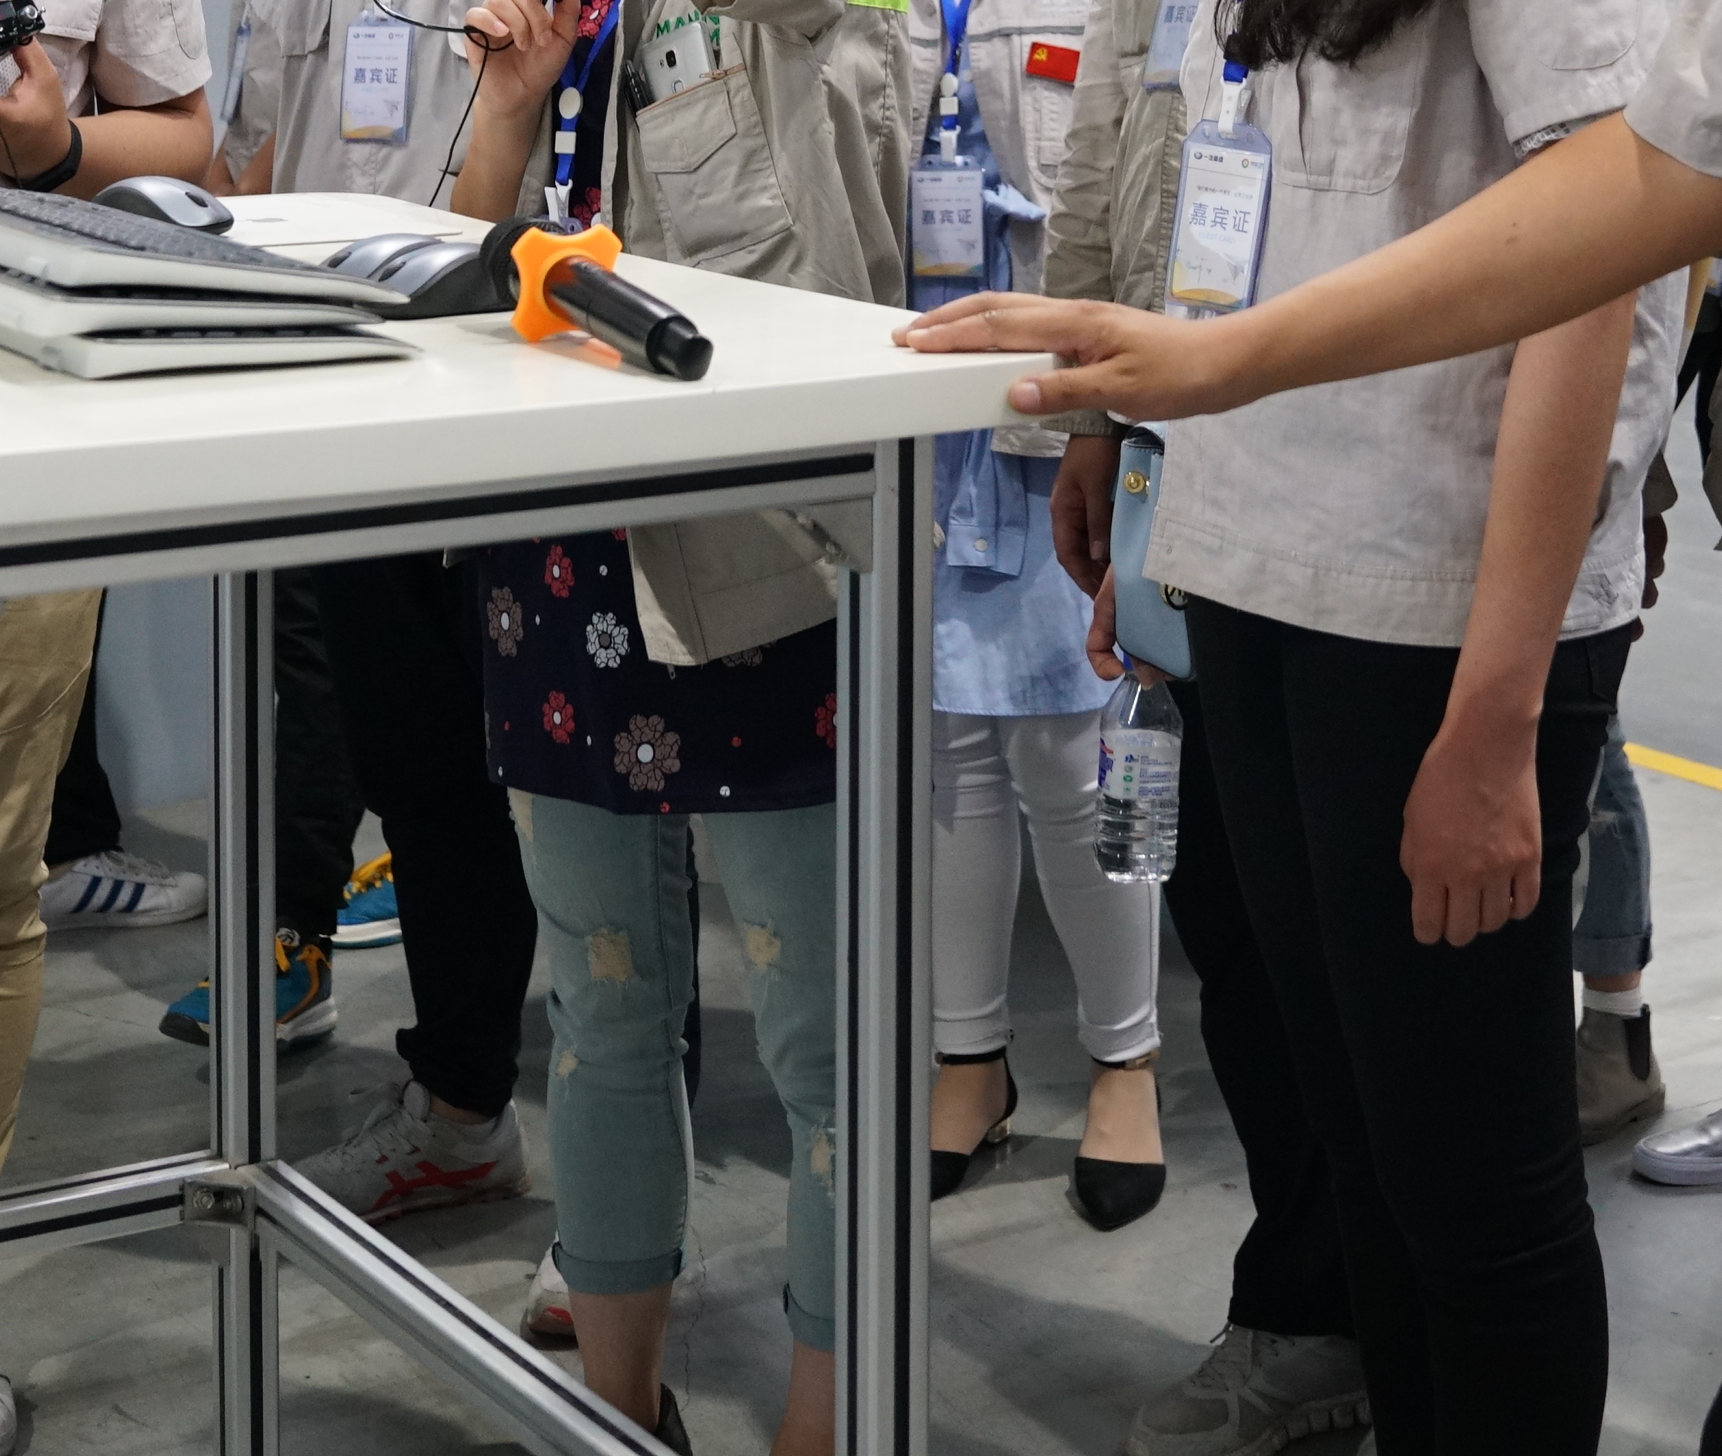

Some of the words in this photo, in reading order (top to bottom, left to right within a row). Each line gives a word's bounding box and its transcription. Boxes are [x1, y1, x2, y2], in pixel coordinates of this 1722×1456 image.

[353, 68, 398, 85] 嘉宾证
[922, 209, 973, 225] 嘉宾证
[1189, 202, 1252, 234] 嘉宾证
